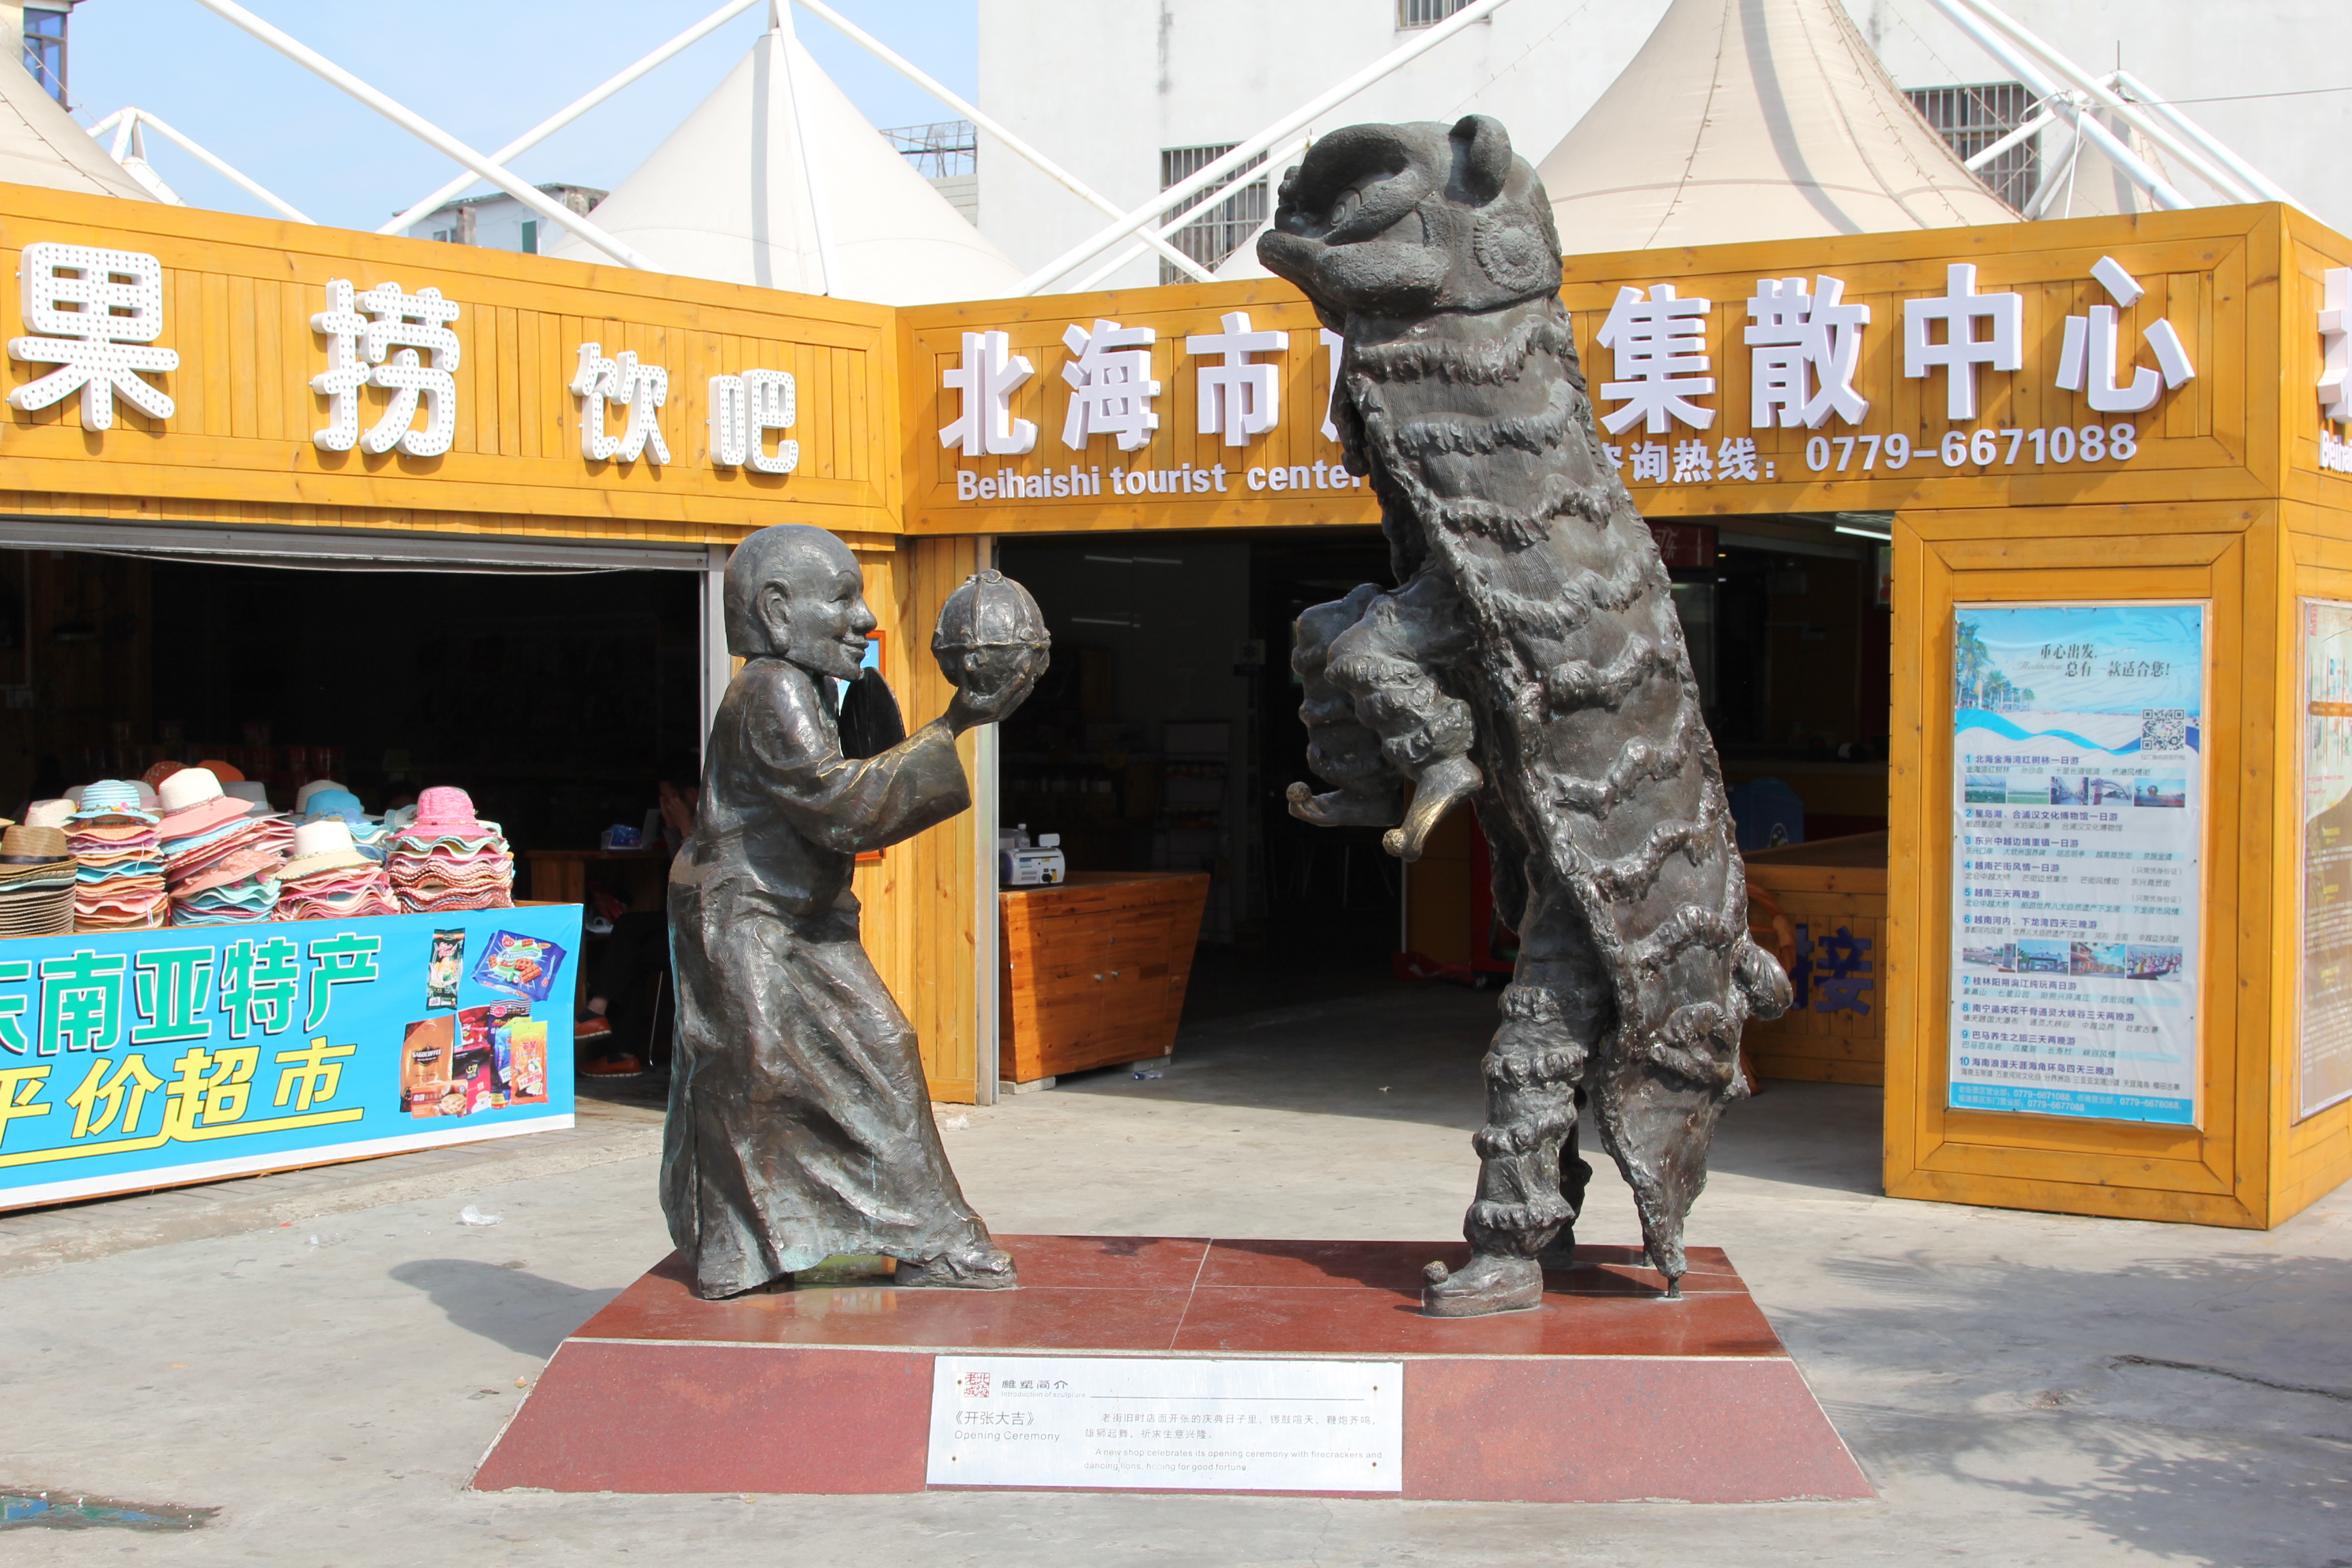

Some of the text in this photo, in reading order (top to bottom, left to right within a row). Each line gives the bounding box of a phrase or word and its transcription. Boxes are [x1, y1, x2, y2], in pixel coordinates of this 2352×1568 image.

[1597, 255, 2195, 436] 集散中心
[1806, 423, 2137, 472] 0779-6671088
[957, 466, 1100, 501] Beihaishi
[1111, 463, 1227, 495] tourist
[1959, 1057, 1970, 1066] 10
[953, 1410, 1036, 1427] 《开张大吉》
[954, 1430, 1060, 1443] Opening Ceremony
[1124, 1448, 1145, 1457] shop
[1147, 1448, 1192, 1457] celebrates
[1208, 1450, 1243, 1458] opening
[1245, 1451, 1288, 1459] ceremony
[1311, 1450, 1362, 1458] firecrackers
[1083, 1463, 1118, 1471] dancing
[1192, 1463, 1213, 1471] good
